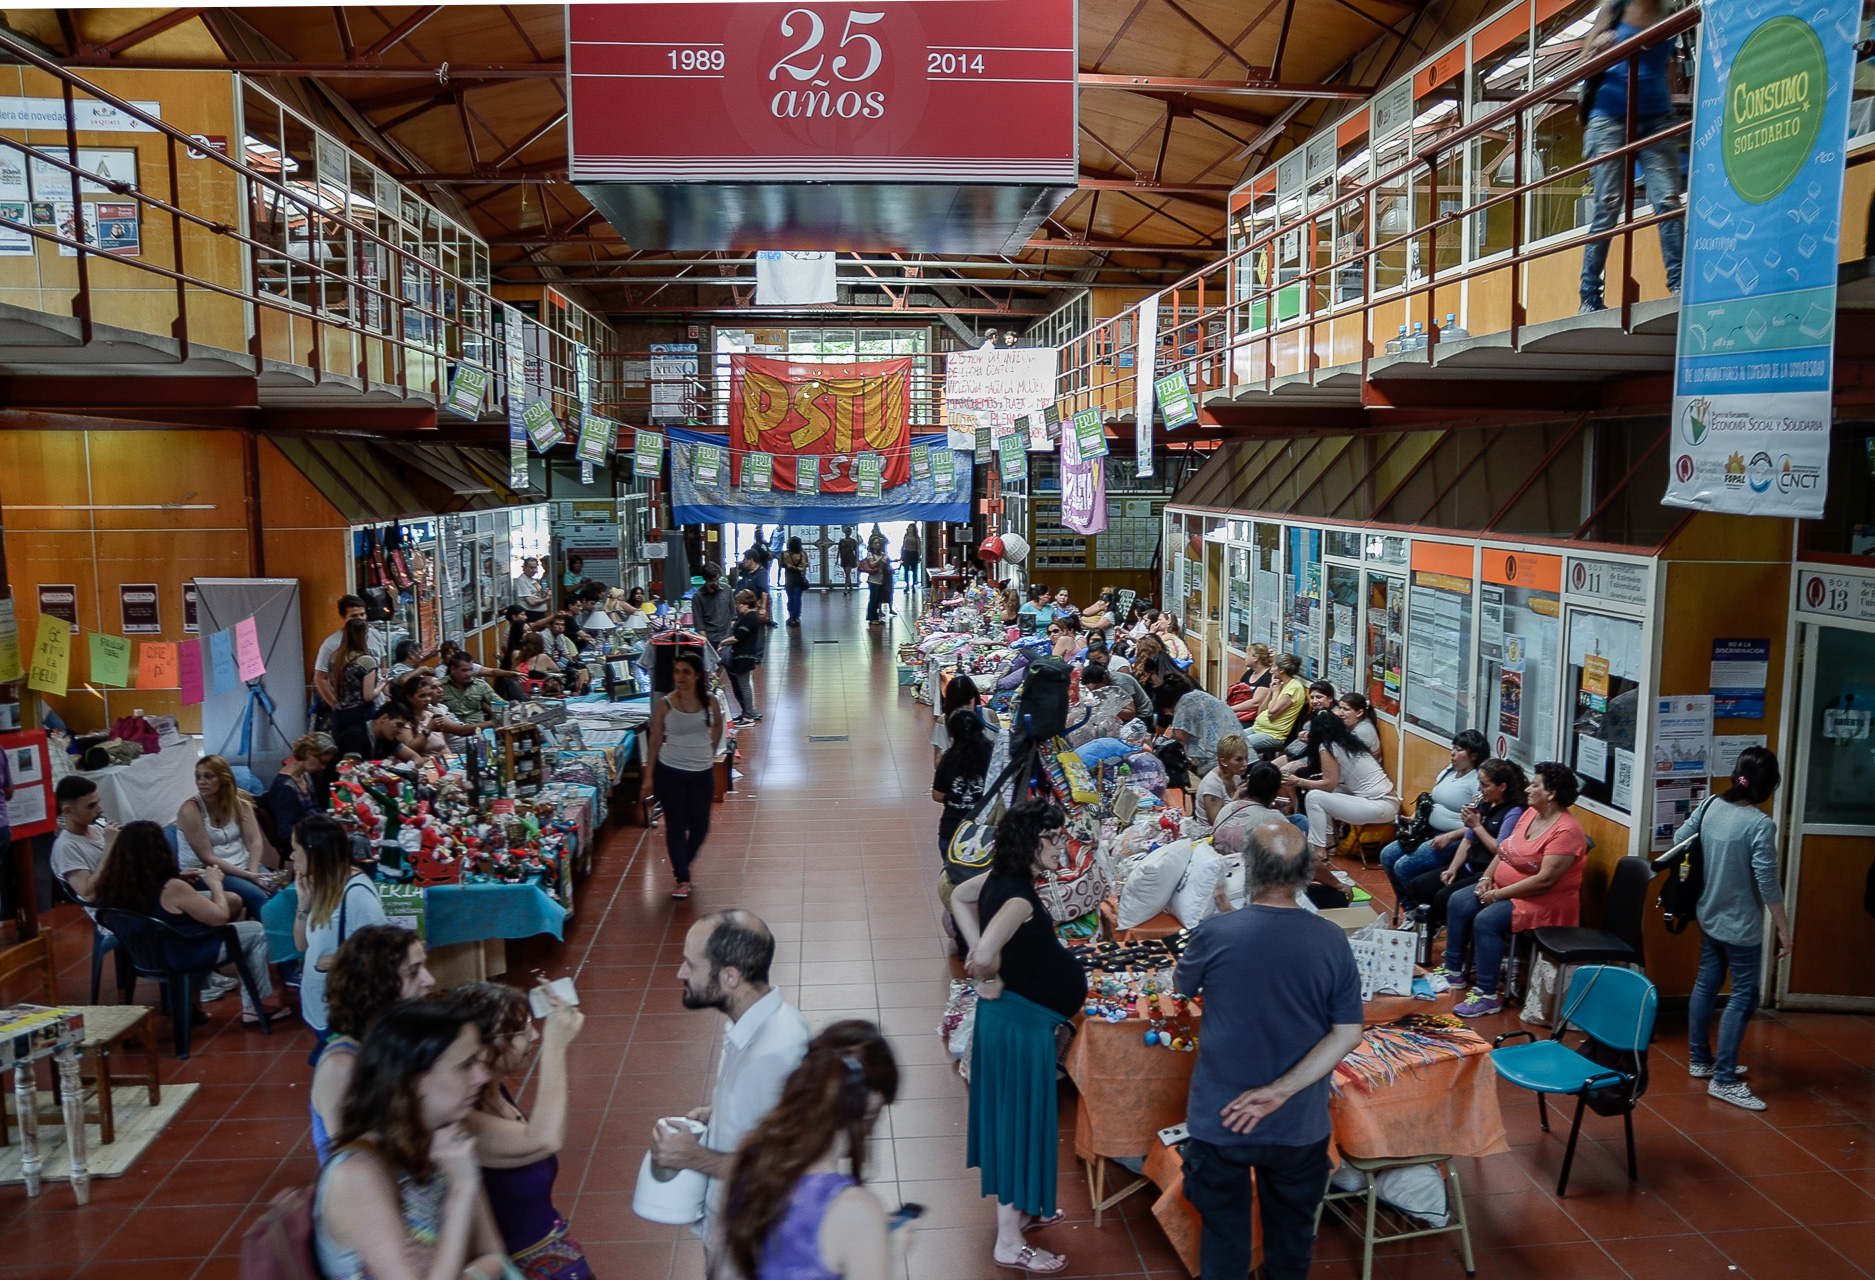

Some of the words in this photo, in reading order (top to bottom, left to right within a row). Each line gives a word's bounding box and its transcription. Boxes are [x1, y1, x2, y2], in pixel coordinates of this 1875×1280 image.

[769, 8, 886, 82] 25
[667, 49, 726, 71] 1989
[928, 53, 986, 75] 2014
[771, 80, 886, 119] años
[1733, 70, 1810, 125] CONSUMO
[18, 110, 29, 120] de
[1734, 116, 1801, 156] SOLIDARIO
[458, 366, 486, 388] FERIA
[1157, 375, 1186, 397] FERIA
[522, 400, 549, 426] FERIA
[743, 368, 903, 454] PSTU
[1074, 410, 1099, 430] FERIA
[583, 417, 609, 435] FERIA
[637, 433, 662, 450] FERIA
[1000, 434, 1023, 452] FERIA
[1780, 473, 1820, 489] CNCT
[1588, 572, 1601, 594] 11
[1828, 578, 1850, 588] BOX
[1828, 589, 1849, 612] 13
